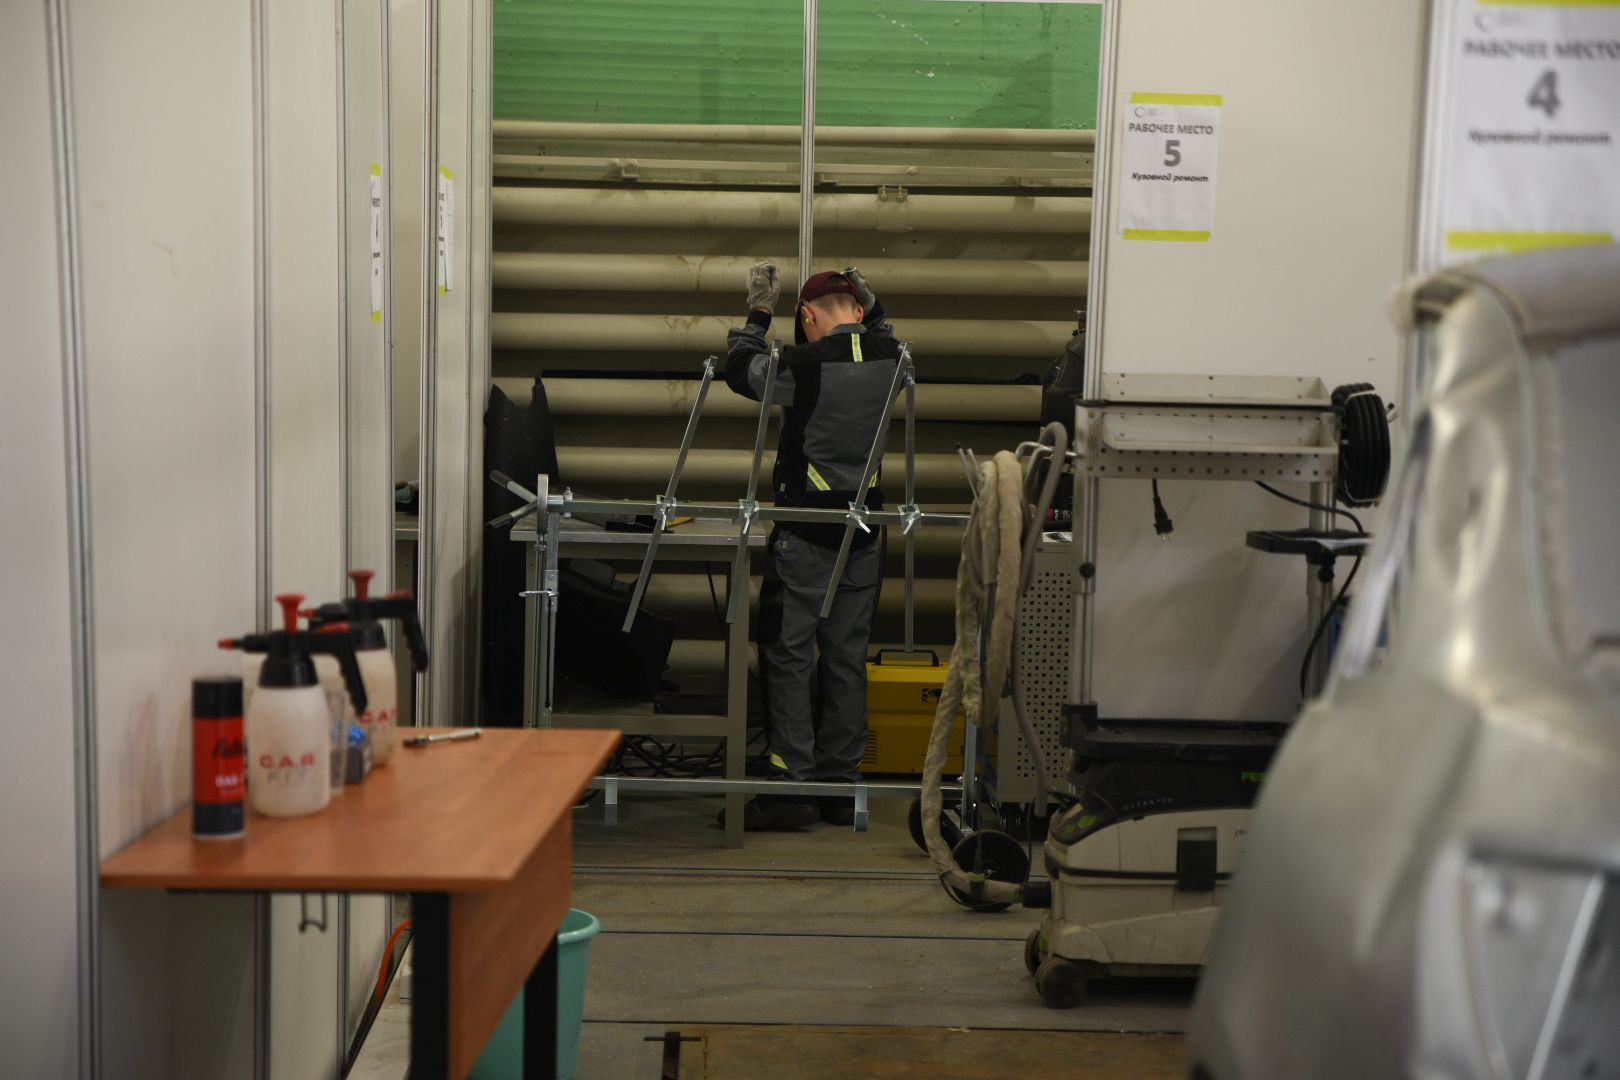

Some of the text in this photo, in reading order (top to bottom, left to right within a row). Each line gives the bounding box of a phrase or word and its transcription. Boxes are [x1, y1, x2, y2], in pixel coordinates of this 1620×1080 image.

[1527, 68, 1561, 118] 4
[1128, 123, 1214, 135] РАБОЧЕЕ МЕСТО
[1163, 140, 1182, 167] 5
[1131, 172, 1209, 183] Кузовной ремонт
